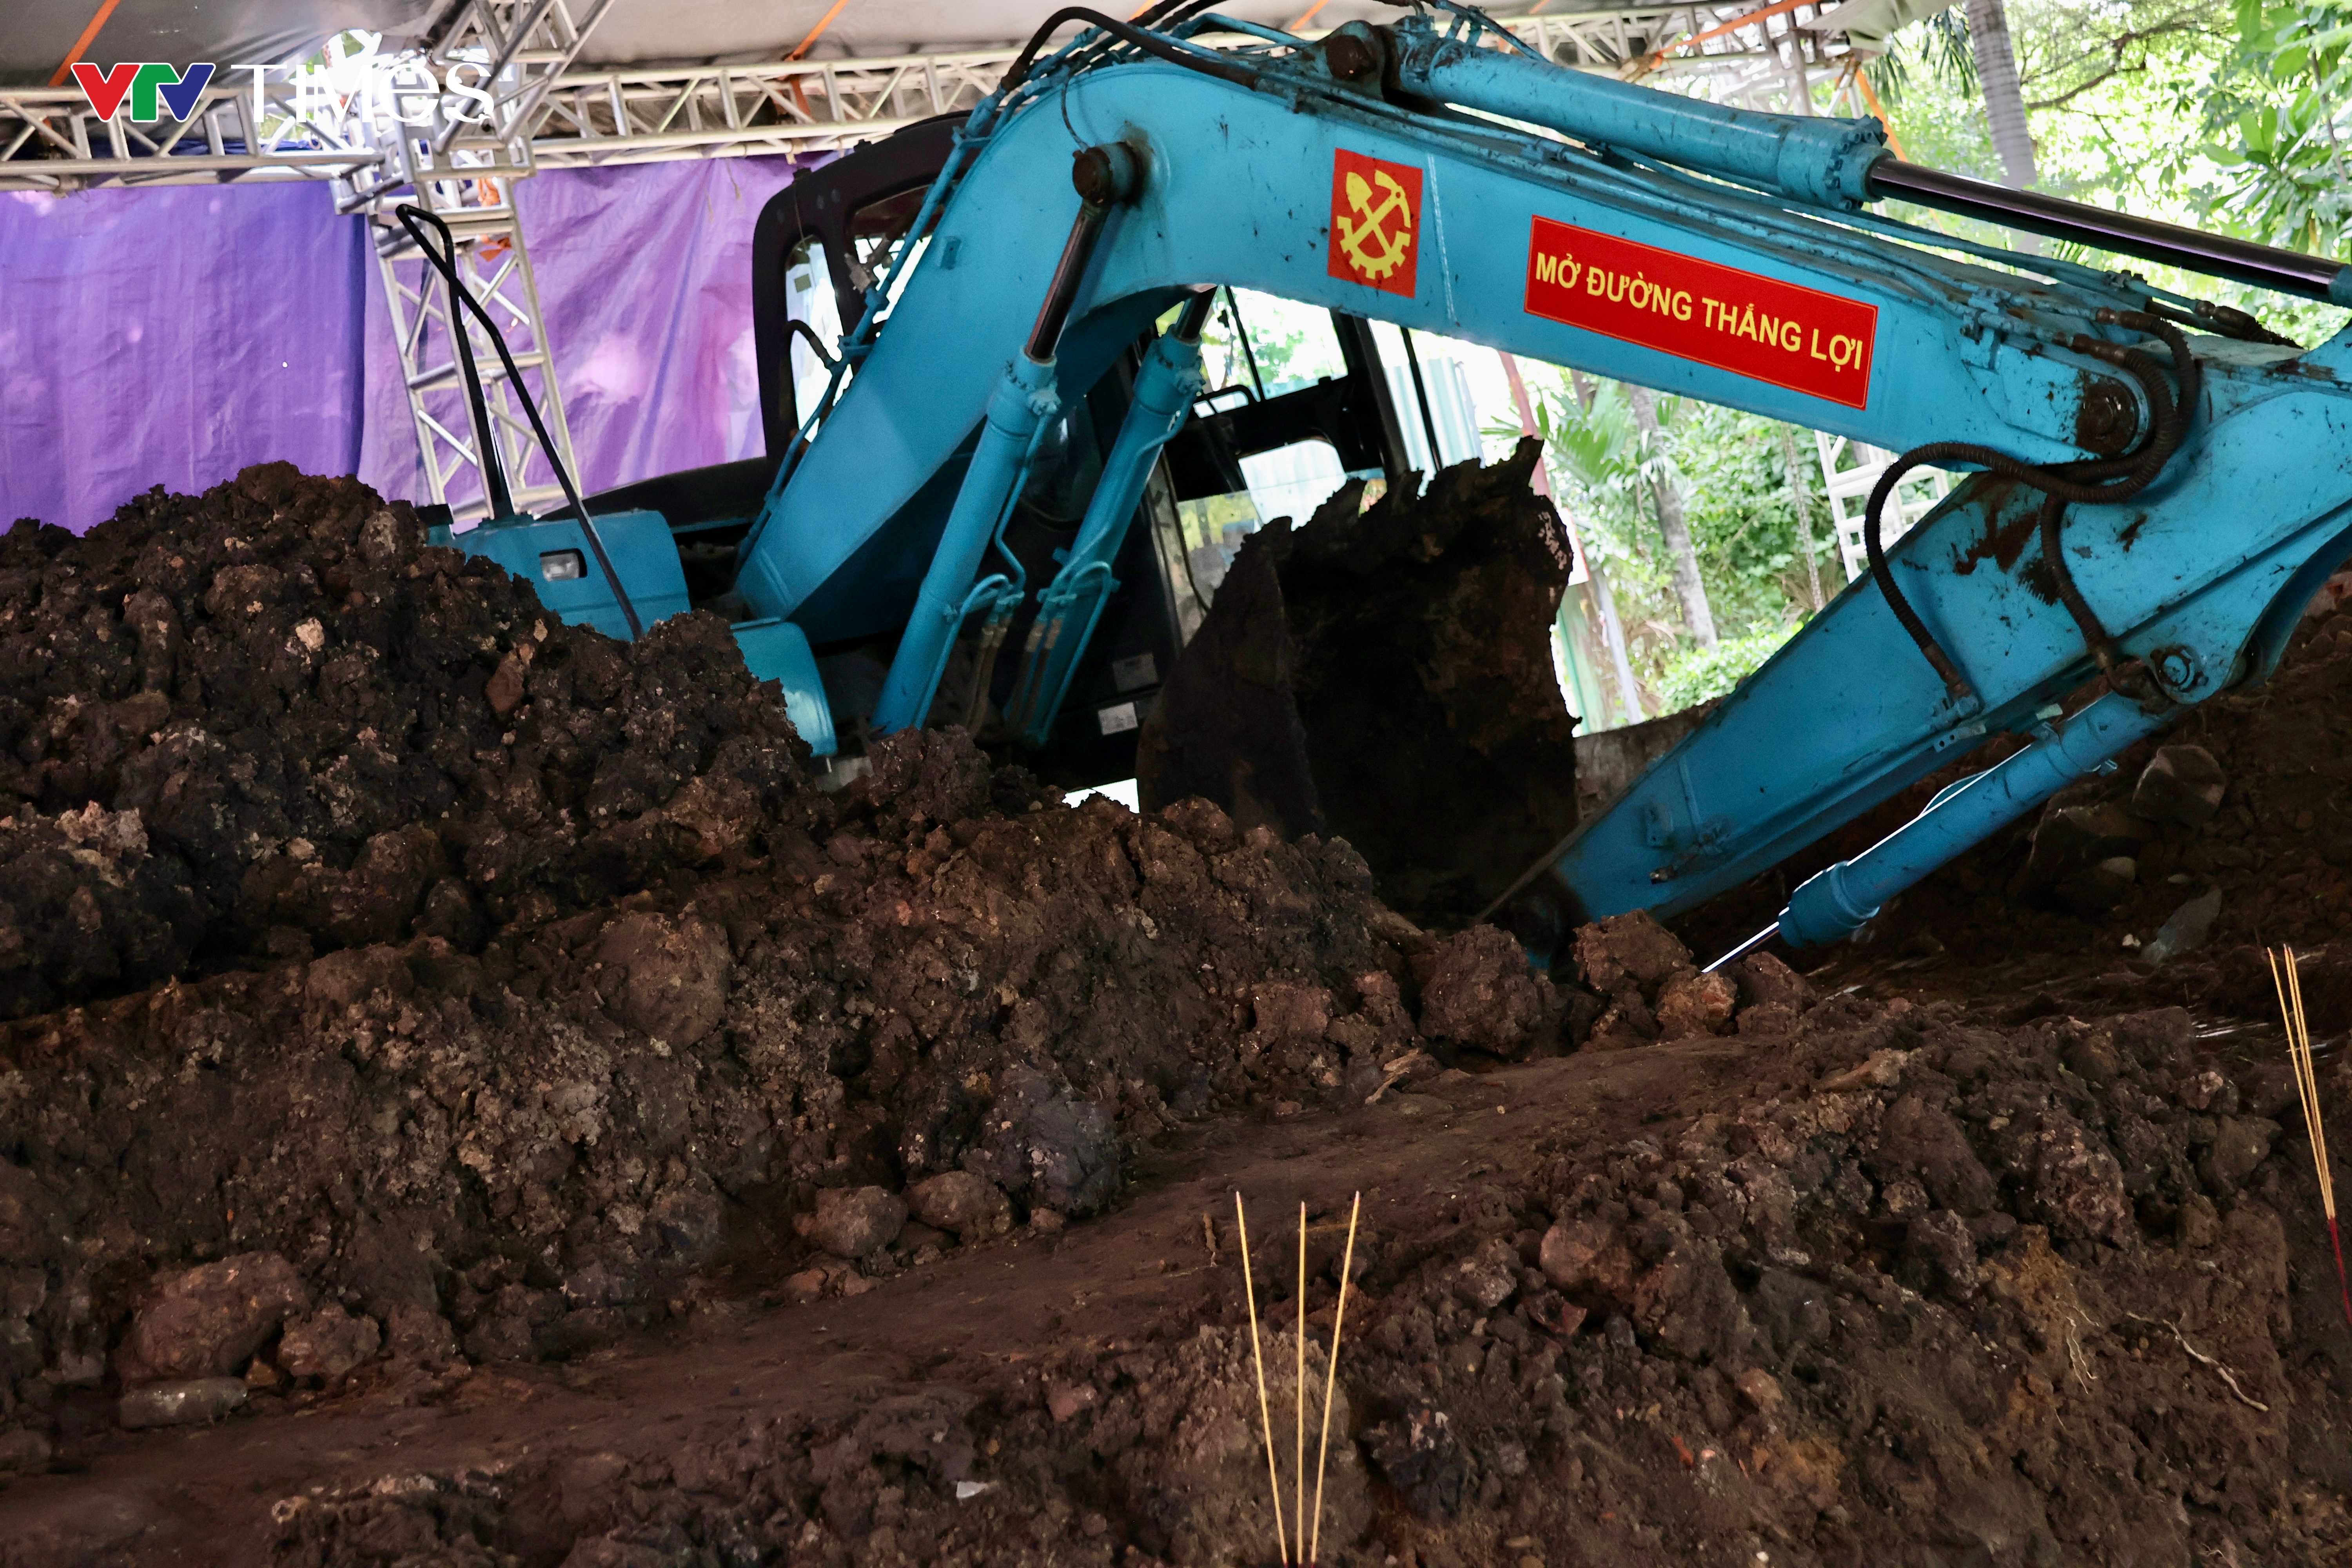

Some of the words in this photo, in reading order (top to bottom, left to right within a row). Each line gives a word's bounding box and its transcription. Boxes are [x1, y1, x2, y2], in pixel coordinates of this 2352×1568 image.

[1536, 252, 1581, 288] MỞ
[1586, 267, 1692, 321] ĐƯỜNG
[1701, 297, 1801, 352] THẮNG
[1811, 328, 1863, 372] LỢI
